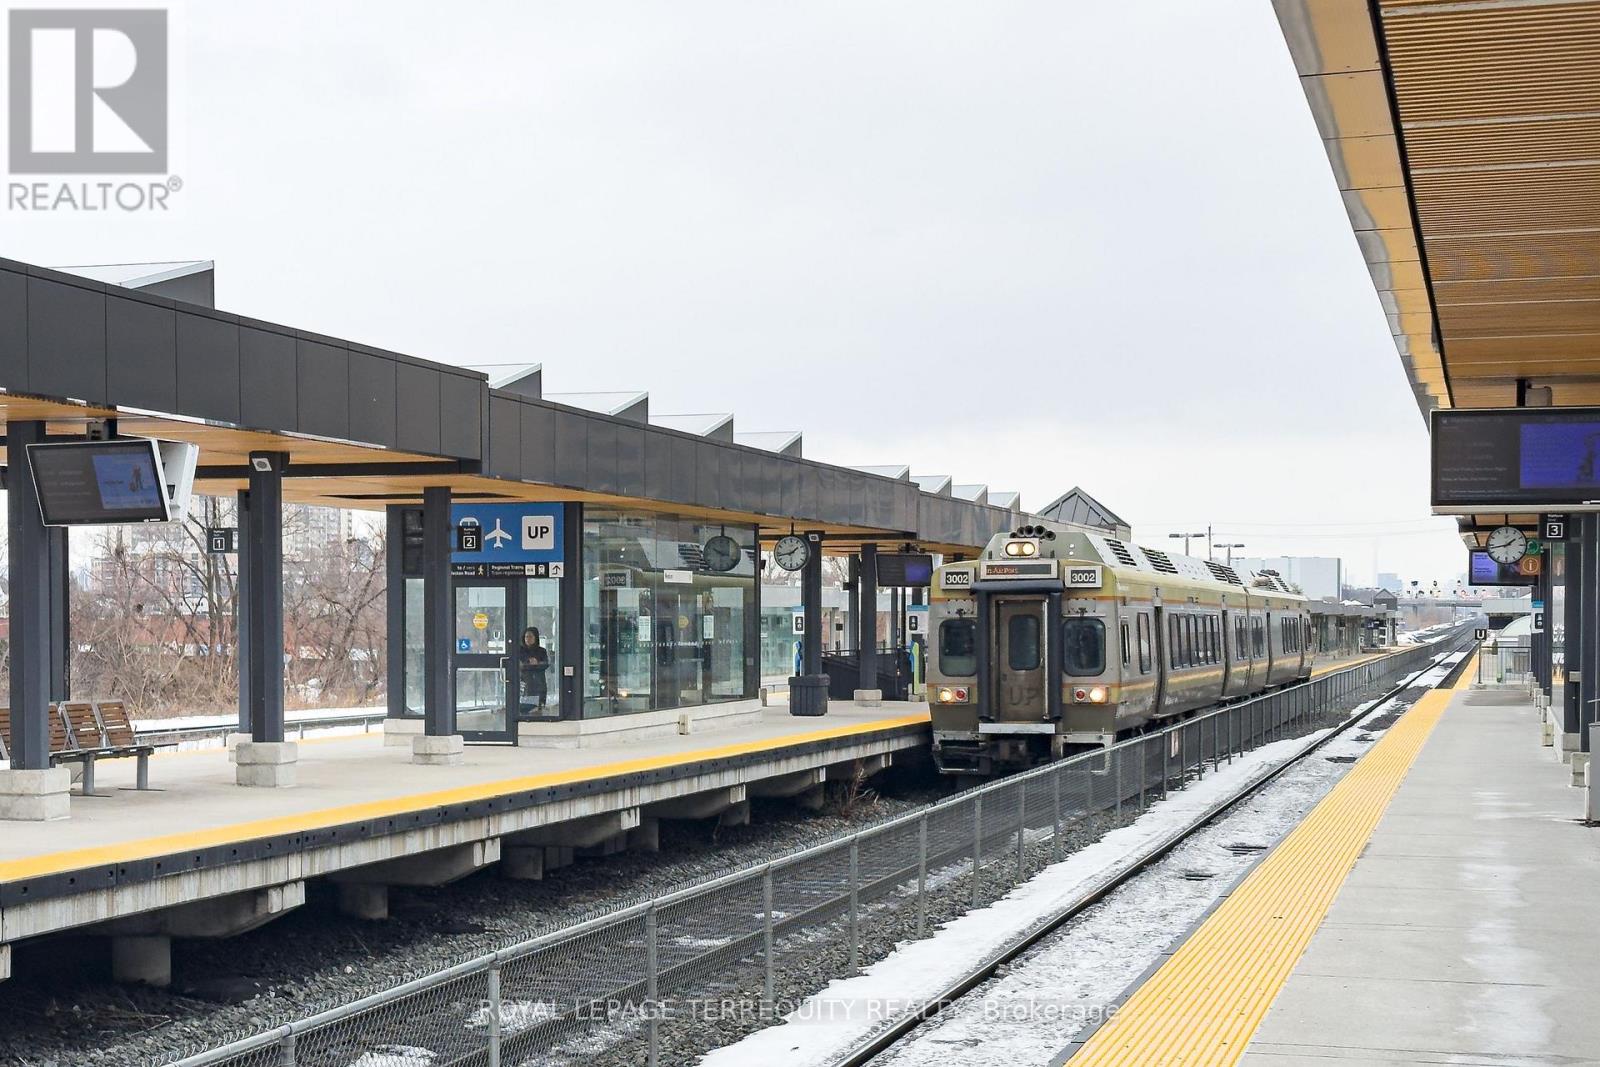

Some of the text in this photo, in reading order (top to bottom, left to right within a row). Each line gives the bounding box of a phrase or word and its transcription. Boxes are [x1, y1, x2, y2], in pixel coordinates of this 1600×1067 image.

[527, 526, 549, 539] UP
[1550, 525, 1558, 535] 3
[466, 537, 472, 547] 2
[946, 574, 968, 584] 3002
[1072, 572, 1096, 582] 3002
[1476, 629, 1485, 639] U
